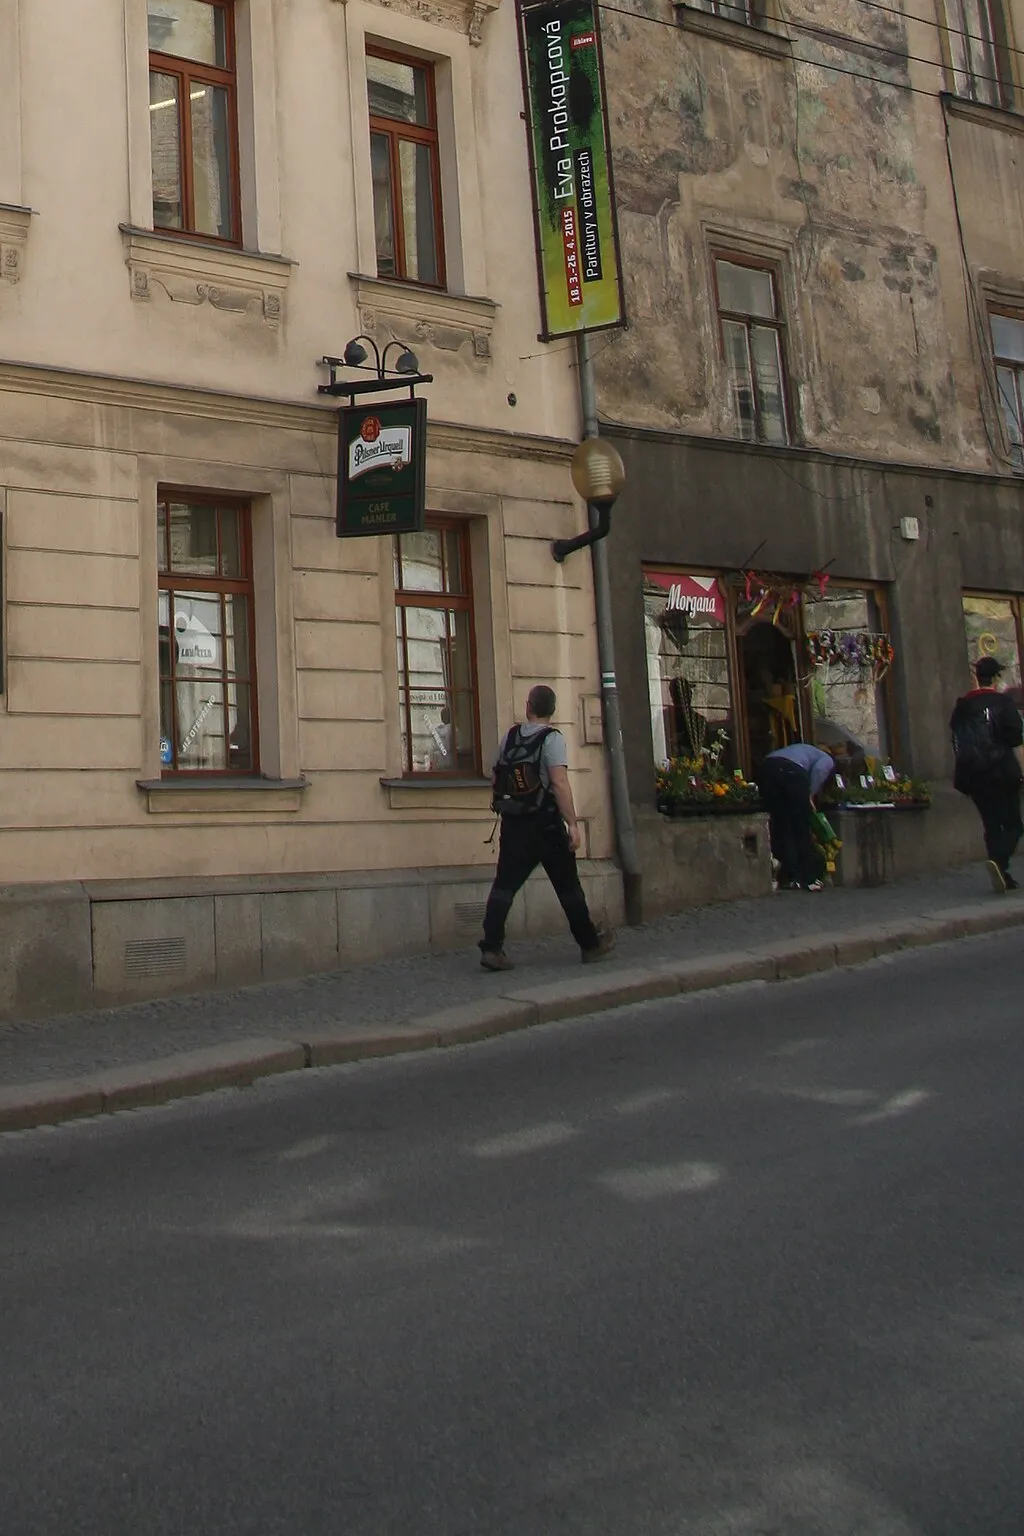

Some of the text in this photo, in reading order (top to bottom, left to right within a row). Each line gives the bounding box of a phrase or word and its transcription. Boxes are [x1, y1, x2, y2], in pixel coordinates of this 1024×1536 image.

[541, 20, 573, 199] Eva Prokopcová
[578, 152, 593, 207] obrazech
[563, 210, 573, 236] 2015
[566, 238, 575, 250] 4.
[585, 222, 598, 277] Partitury
[571, 285, 580, 302] 18.
[354, 438, 404, 467] Pilsner Urquell
[666, 583, 716, 619] Morgana
